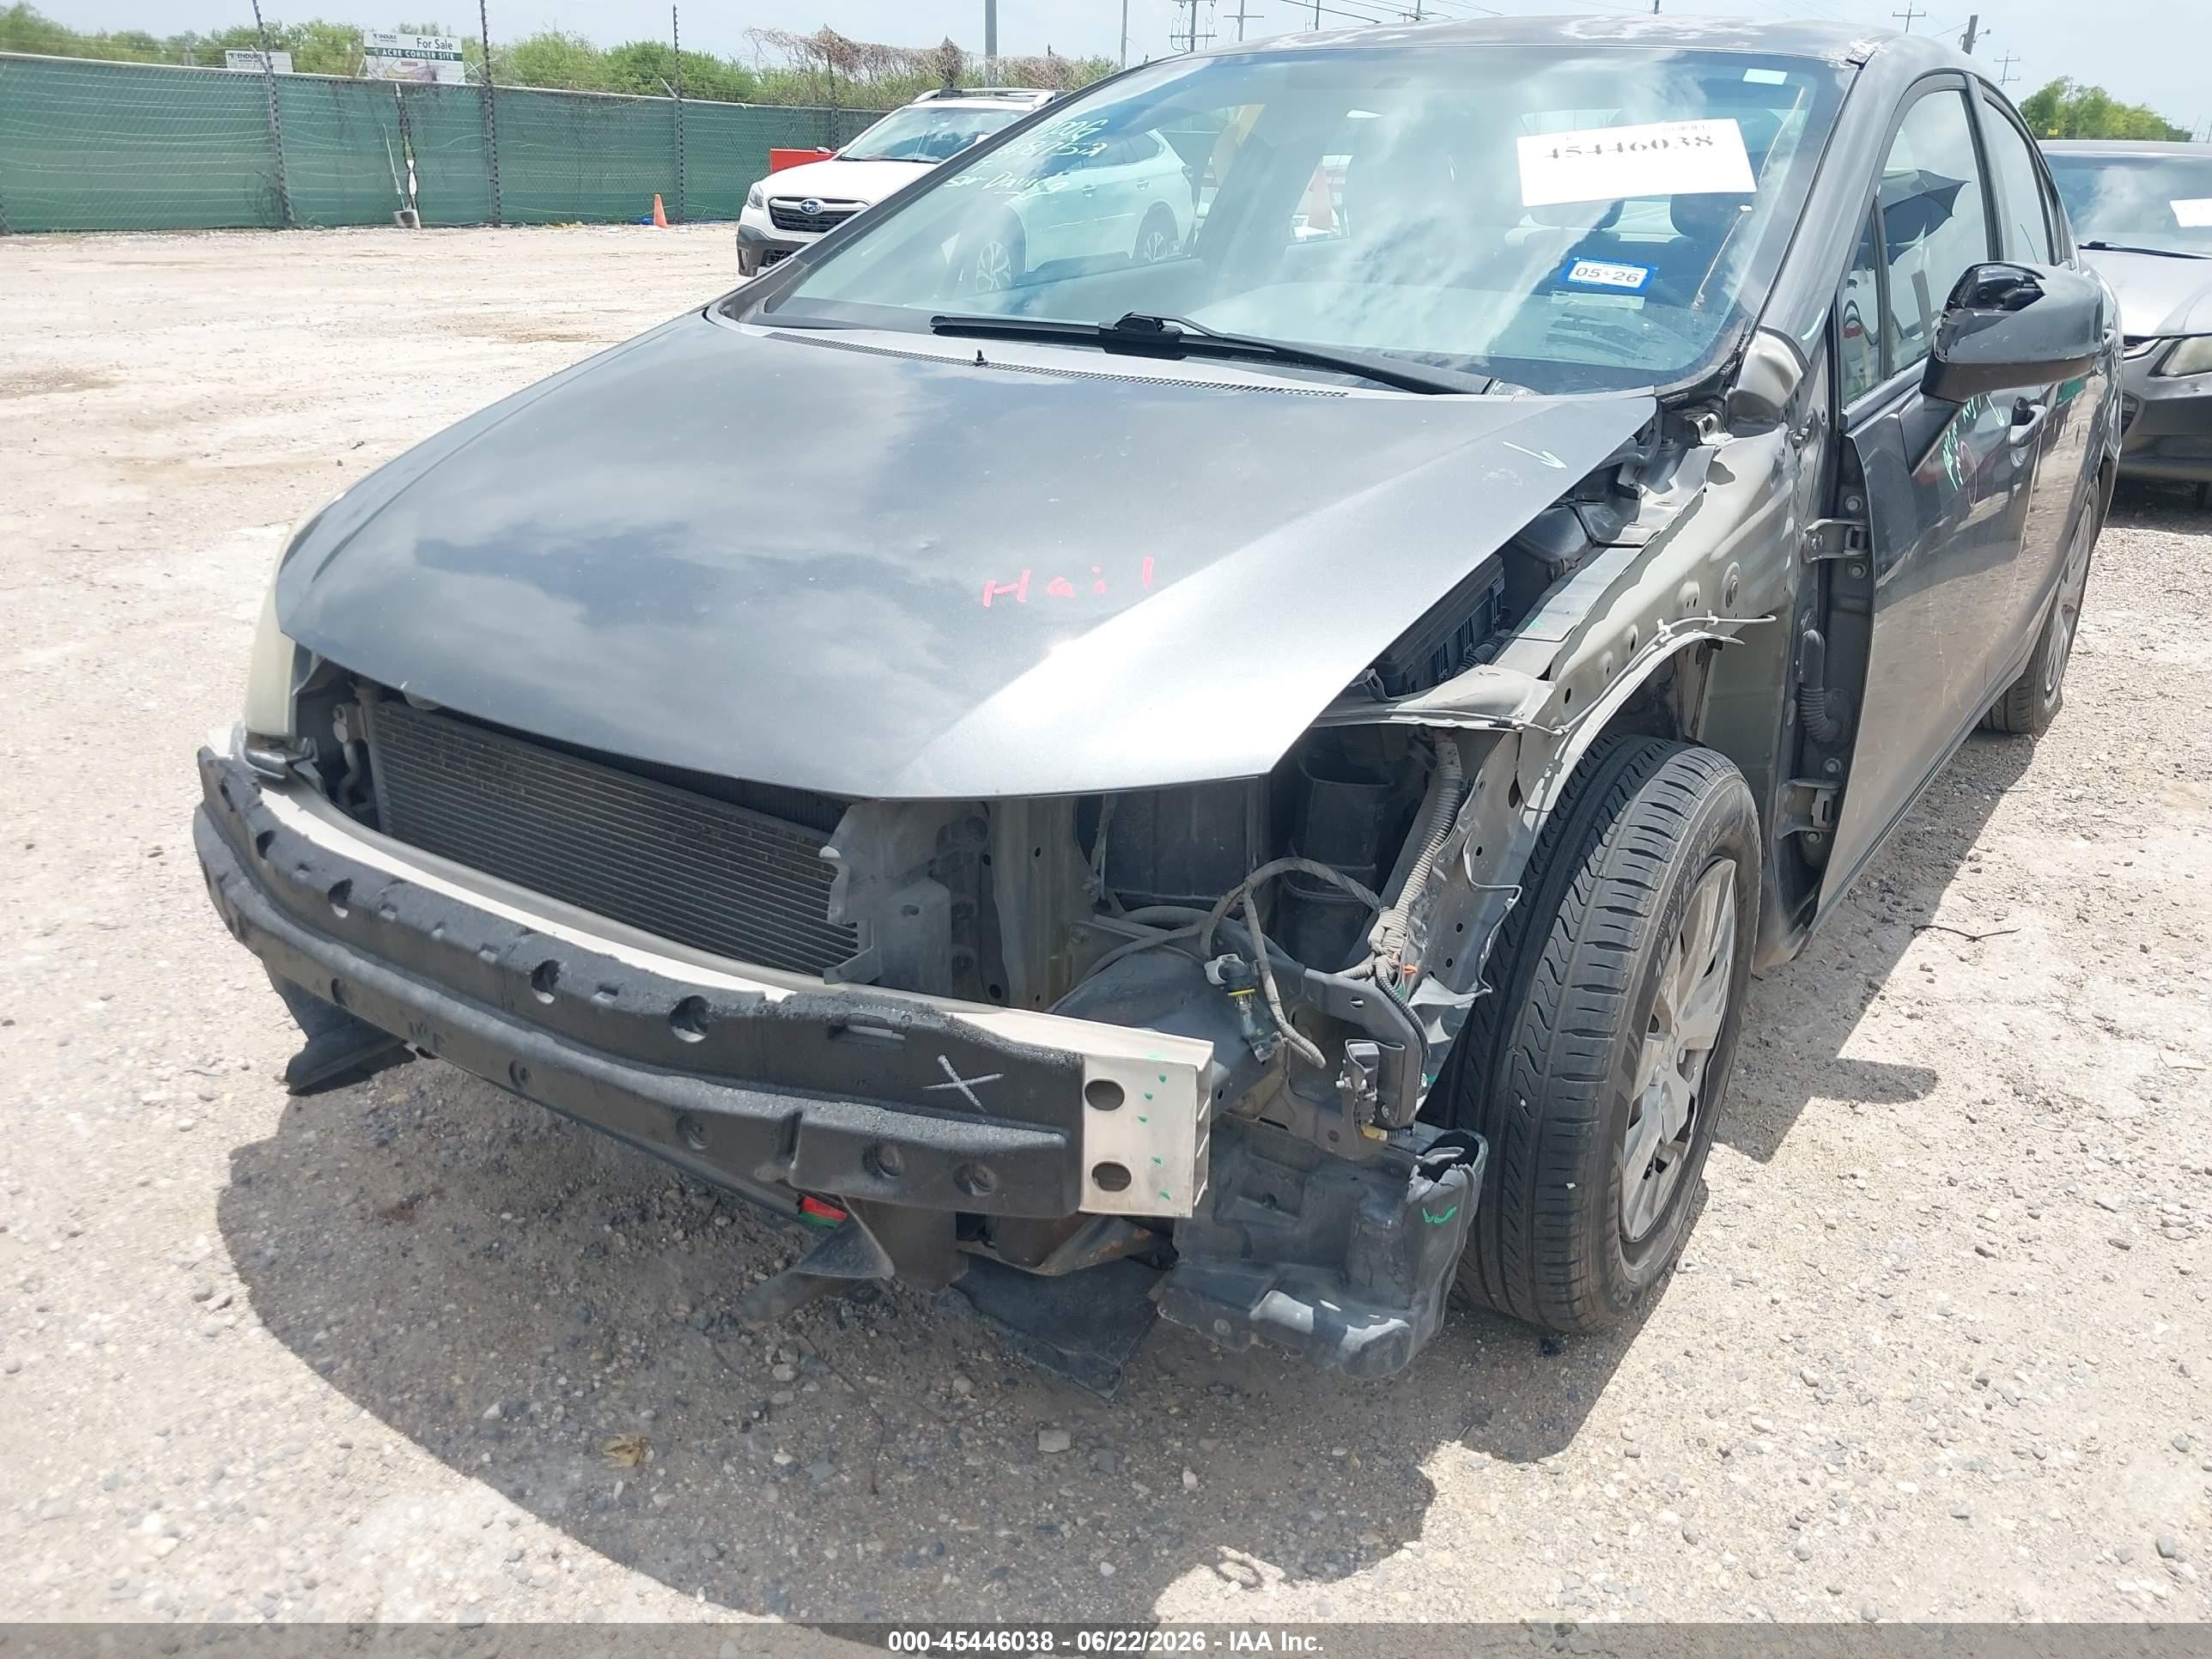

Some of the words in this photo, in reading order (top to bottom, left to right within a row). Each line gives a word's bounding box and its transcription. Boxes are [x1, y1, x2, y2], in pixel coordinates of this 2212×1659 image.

[416, 38, 433, 48] For
[434, 39, 453, 50] Sale
[382, 48, 403, 57] ACRE
[404, 51, 436, 59] CORNER
[439, 52, 454, 61] SITE
[1546, 136, 1713, 159] 45446038
[981, 555, 1155, 609] Hail
